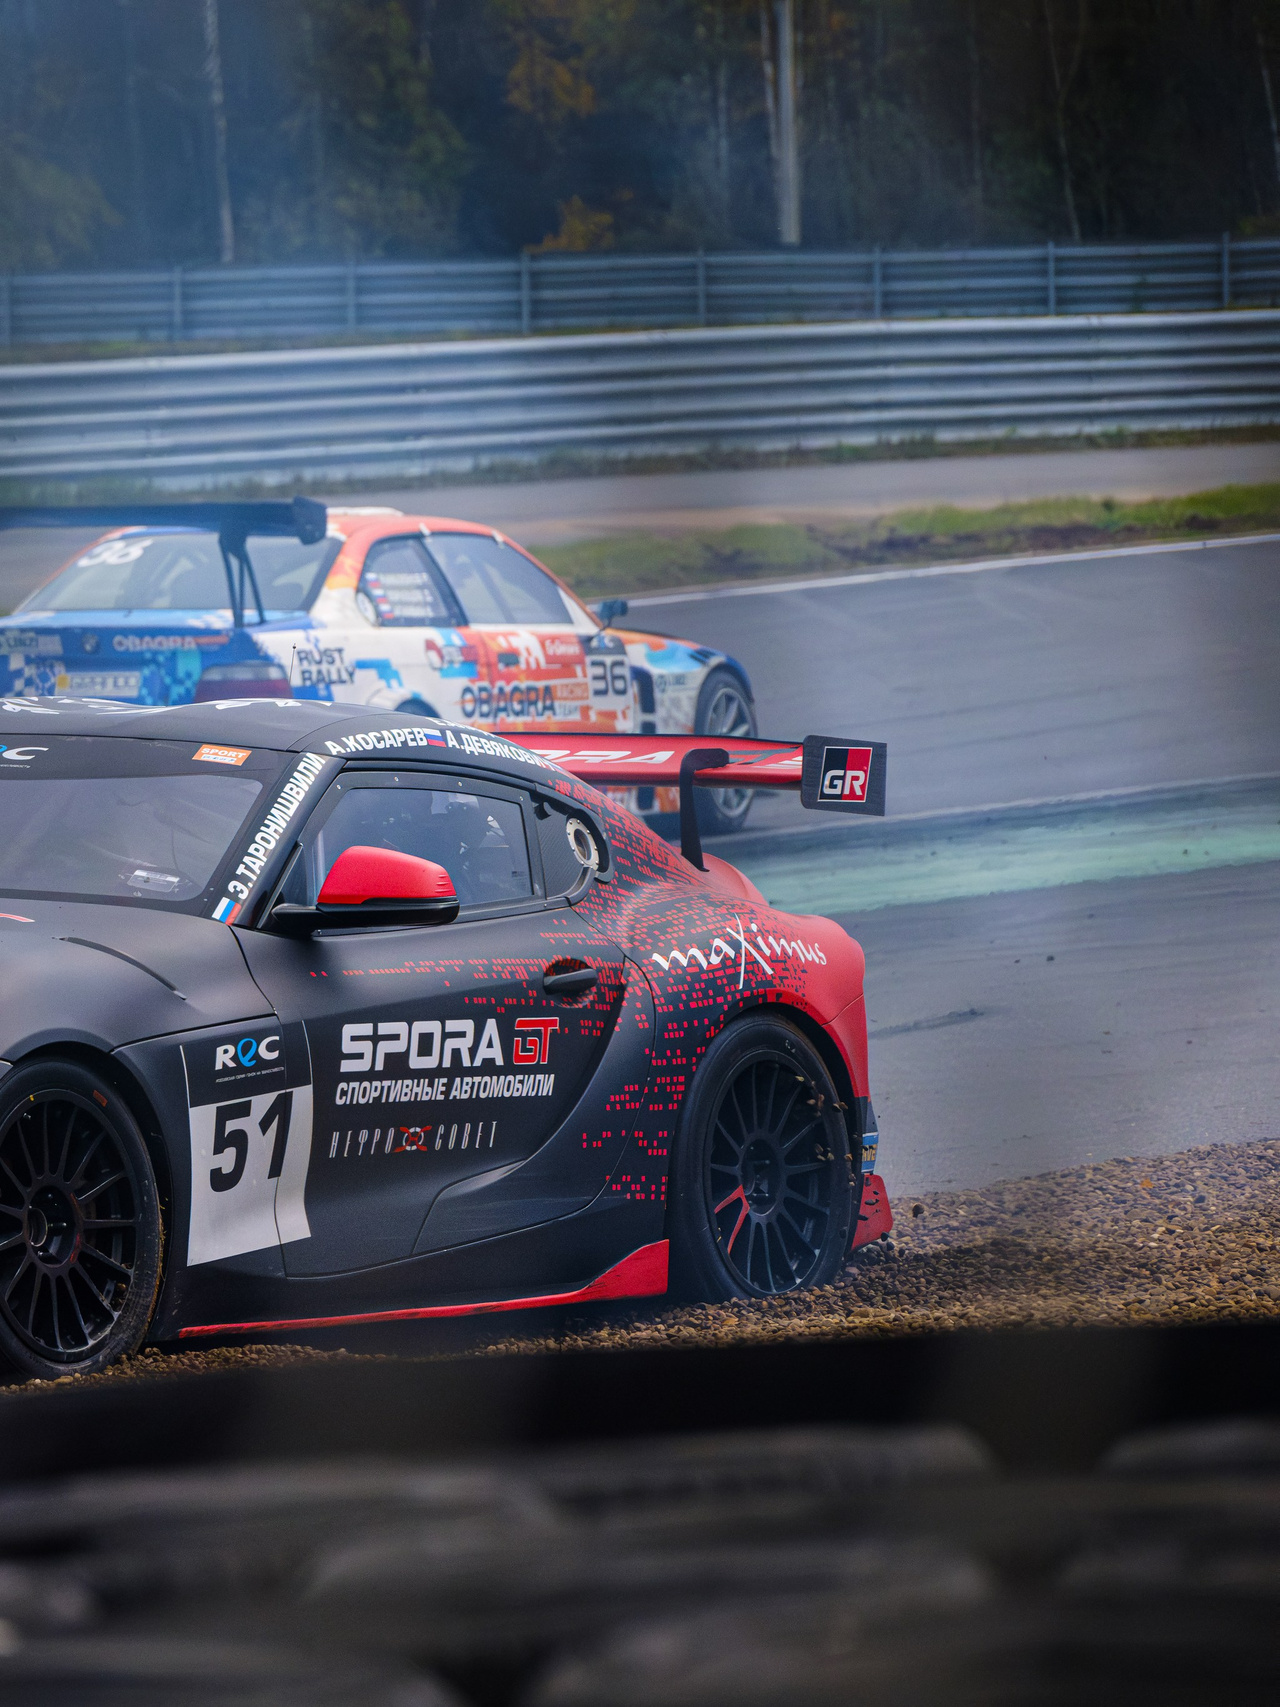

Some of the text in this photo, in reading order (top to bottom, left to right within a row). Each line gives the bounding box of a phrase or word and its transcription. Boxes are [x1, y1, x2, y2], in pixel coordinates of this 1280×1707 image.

[297, 647, 344, 666] RUST
[301, 665, 357, 686] RALLY
[589, 660, 629, 697] 36
[460, 683, 557, 720] OBAGRA
[201, 747, 247, 759] SPORT
[824, 769, 867, 796] GR
[339, 1017, 560, 1073] SPORA GT
[335, 1074, 555, 1106] СПОРТИВНЫЕ АВТОМОБИЛИ
[209, 1090, 294, 1193] 51
